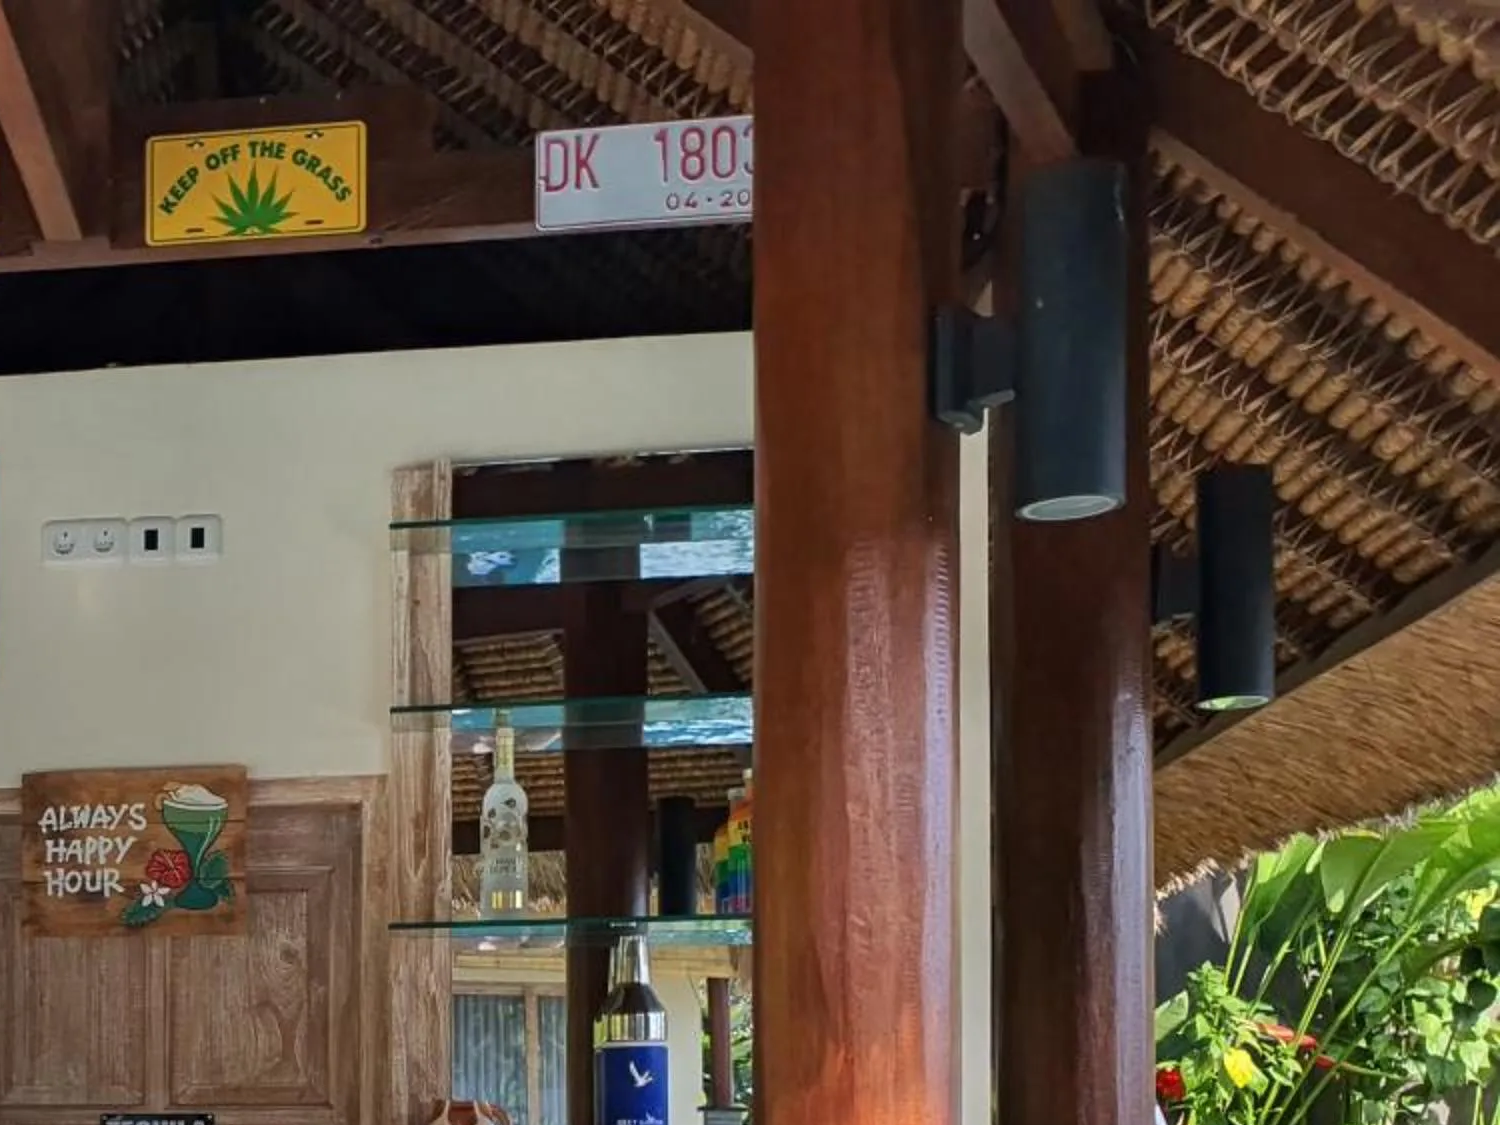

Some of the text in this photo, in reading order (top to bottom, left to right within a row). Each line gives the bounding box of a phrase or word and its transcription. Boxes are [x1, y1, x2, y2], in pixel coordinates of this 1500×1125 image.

[158, 141, 353, 215] KEEP OFF THE GRASS
[544, 133, 600, 192] DK
[37, 803, 148, 834] ALWAYS
[45, 836, 138, 865] HAPPY
[43, 867, 125, 898] HOUR
